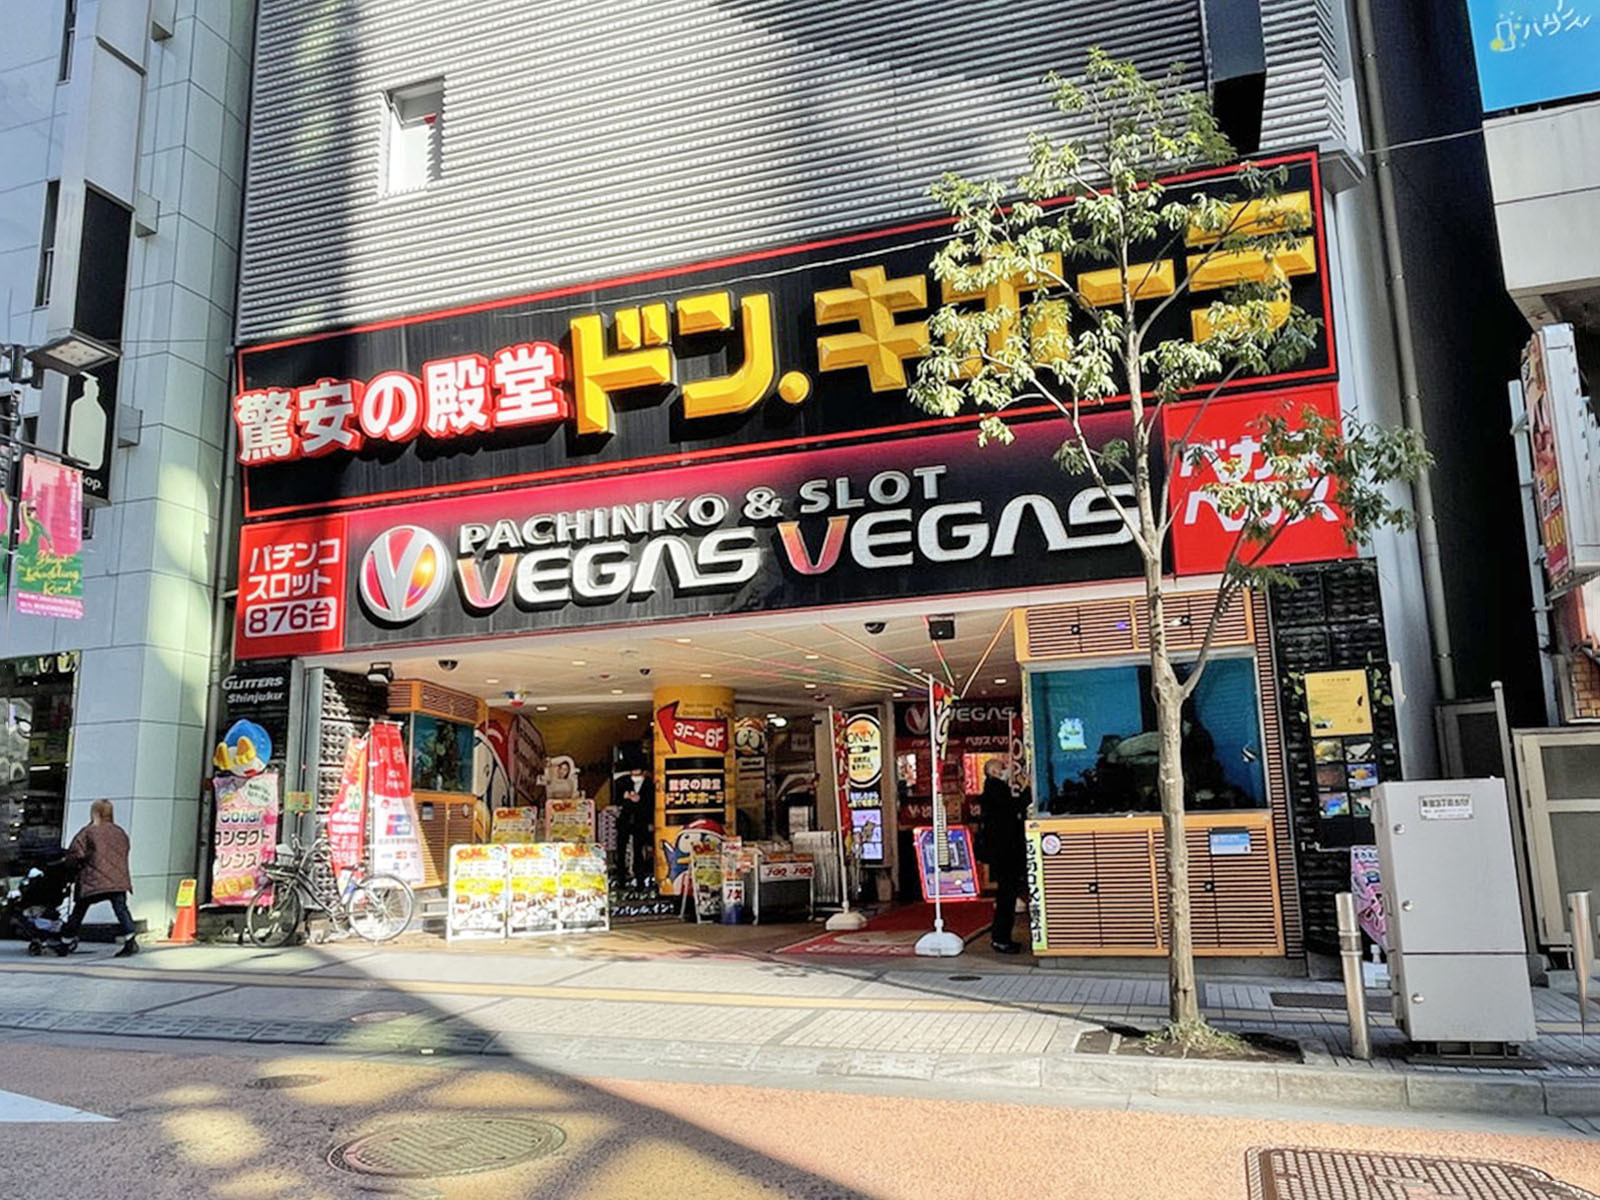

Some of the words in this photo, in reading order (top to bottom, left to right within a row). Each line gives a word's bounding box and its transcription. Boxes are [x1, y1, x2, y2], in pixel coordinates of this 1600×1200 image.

[236, 344, 564, 463] 驚安の殿堂
[459, 493, 730, 555] PACHINKO
[743, 486, 785, 521] &
[798, 464, 948, 514] SLOT
[249, 538, 341, 573] パチンコ
[456, 525, 762, 609] VEGAS
[776, 481, 1143, 575] VEGAS
[246, 569, 332, 602] スロット
[248, 602, 332, 634] 876台
[215, 828, 270, 846] コンタクト
